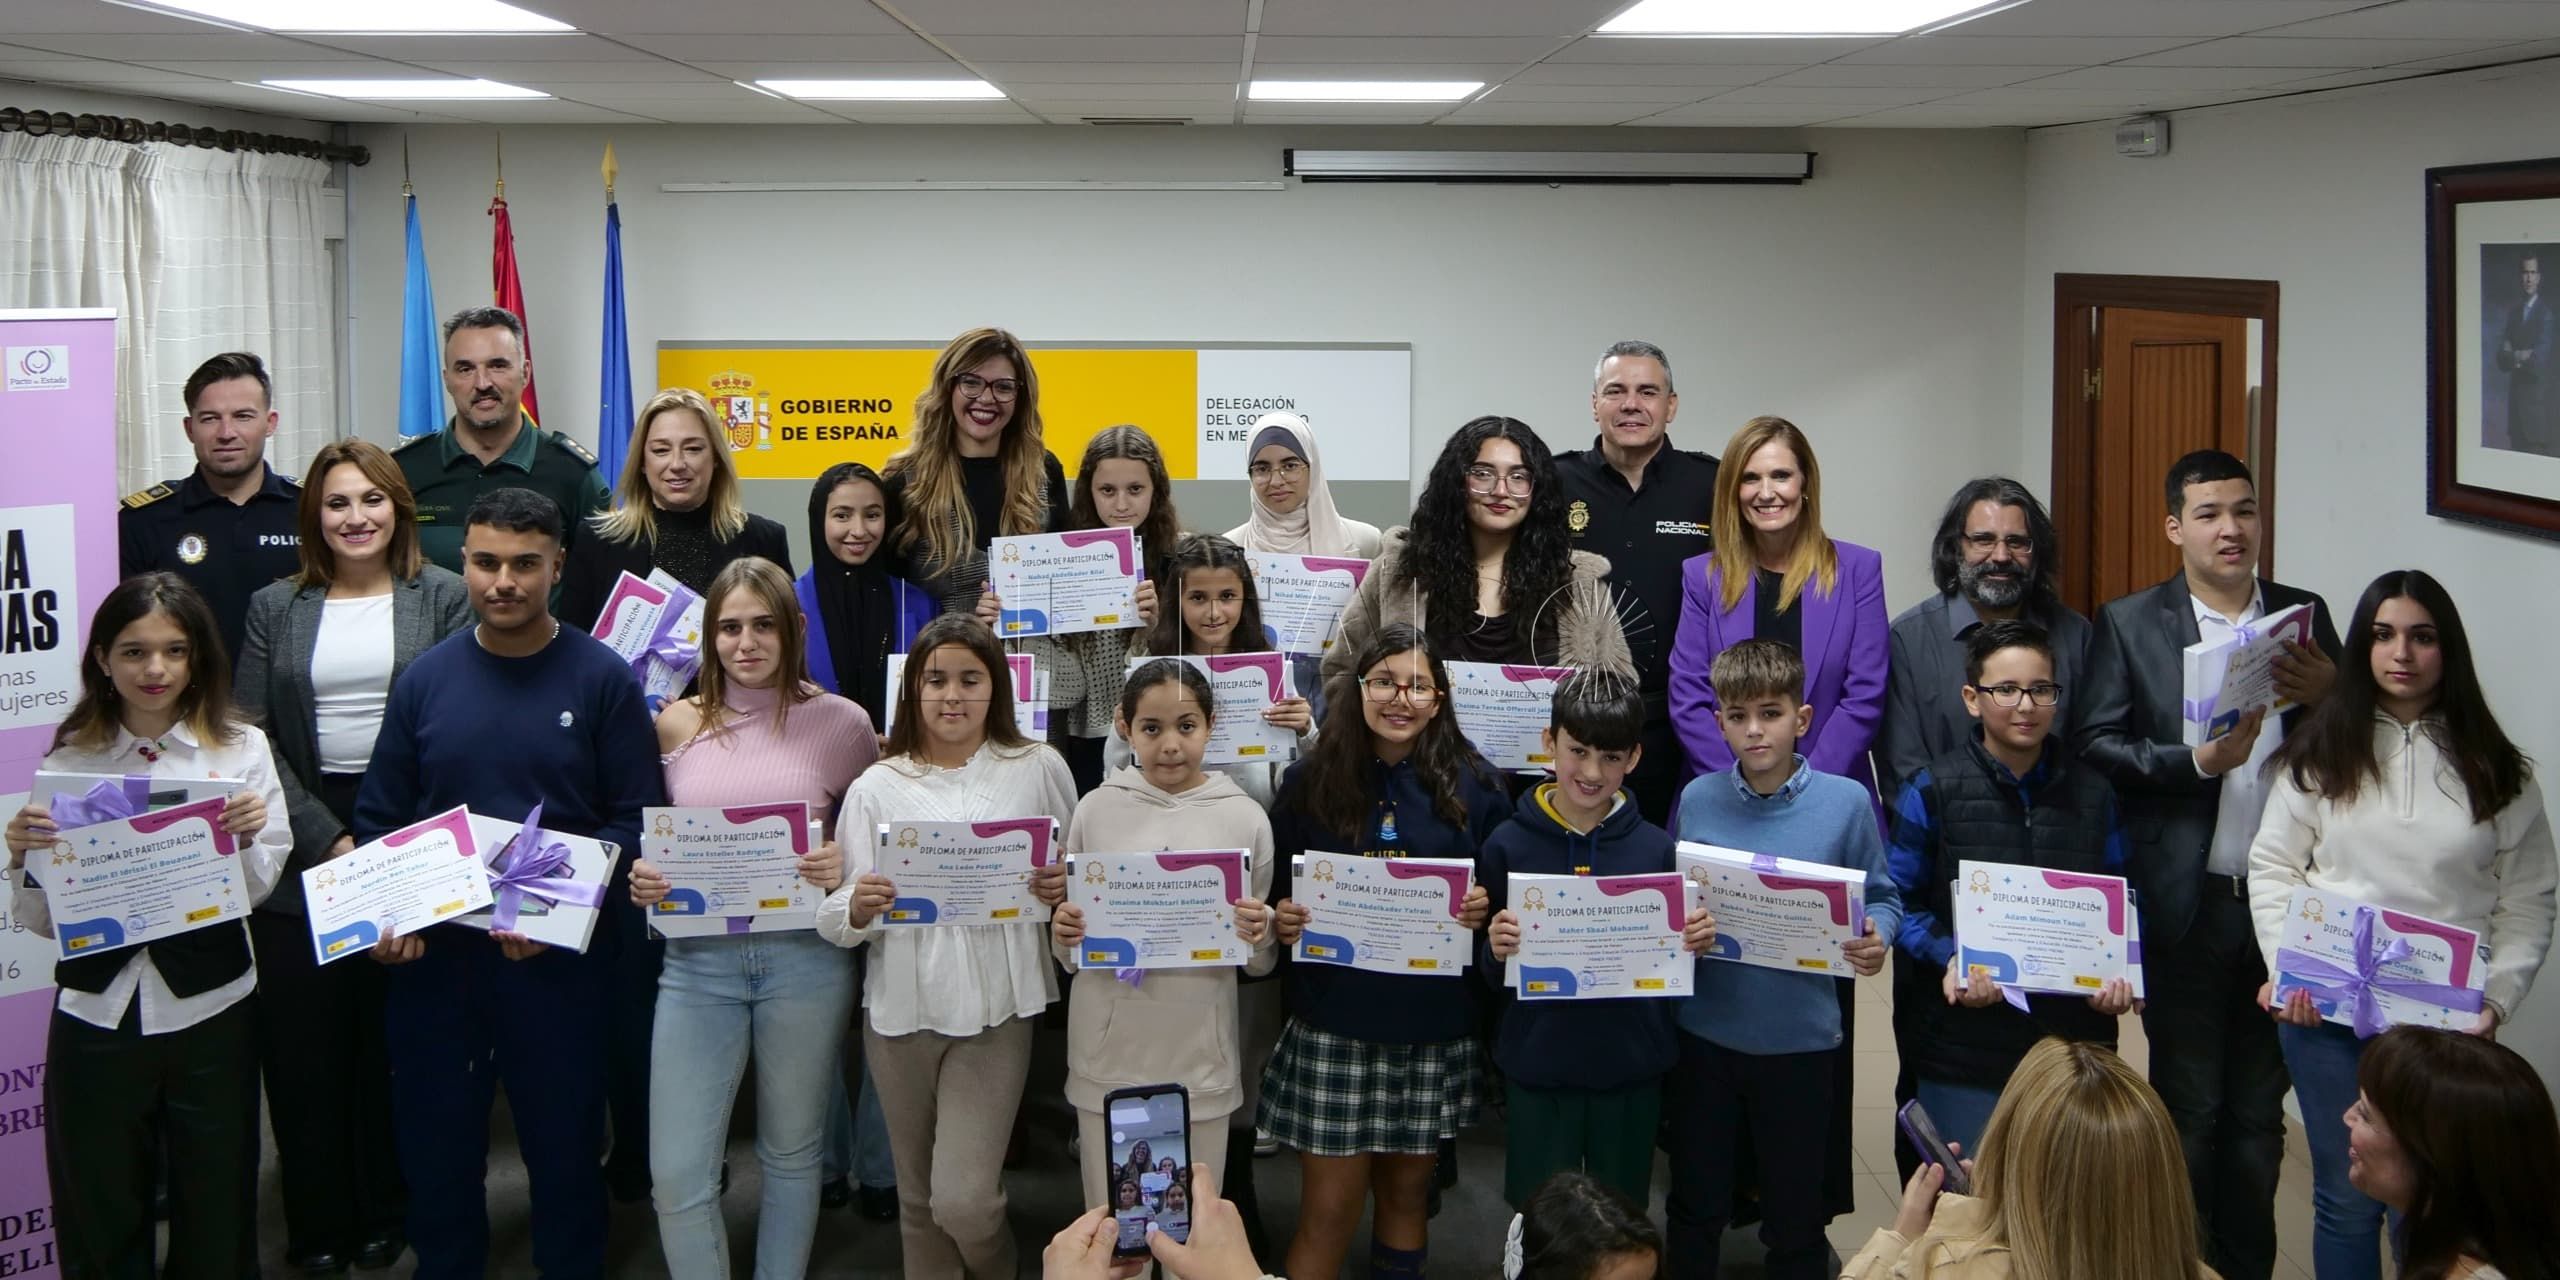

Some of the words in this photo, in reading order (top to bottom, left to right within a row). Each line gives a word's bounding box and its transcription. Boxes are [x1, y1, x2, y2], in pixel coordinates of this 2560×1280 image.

[780, 398, 893, 414] GOBIERNO
[1206, 395, 1295, 410] DELEGACIÓN
[1206, 414, 1232, 426] DEL
[781, 426, 809, 441] DE
[816, 422, 899, 441] ESPAÑA
[1206, 430, 1224, 442] EN
[1655, 527, 1709, 536] NACIONAL
[259, 534, 303, 547] POLIC
[1021, 558, 1053, 568] DIPLOMA
[1211, 678, 1263, 690] ARTICIPACIÓN
[1457, 687, 1489, 696] DIPLOMA
[1490, 688, 1499, 696] DE
[677, 833, 711, 843] DIPLOMA
[713, 834, 722, 843] DE
[919, 846, 956, 855] DIPLOMA
[957, 847, 966, 855] DE
[80, 851, 122, 867] DIPLOMA
[123, 848, 134, 859] DE
[1109, 880, 1145, 890] DIPLOMA
[1146, 881, 1155, 890] DE
[1335, 881, 1370, 894] DIPLOMA
[1372, 886, 1382, 896] DE
[1711, 886, 1747, 900] DIPLOMA
[1749, 893, 1758, 902] DE
[1992, 892, 2029, 905] DIPLOMA
[2031, 896, 2041, 906] DE
[1547, 907, 1585, 917] DIPLOMA
[1586, 907, 1596, 917] DE
